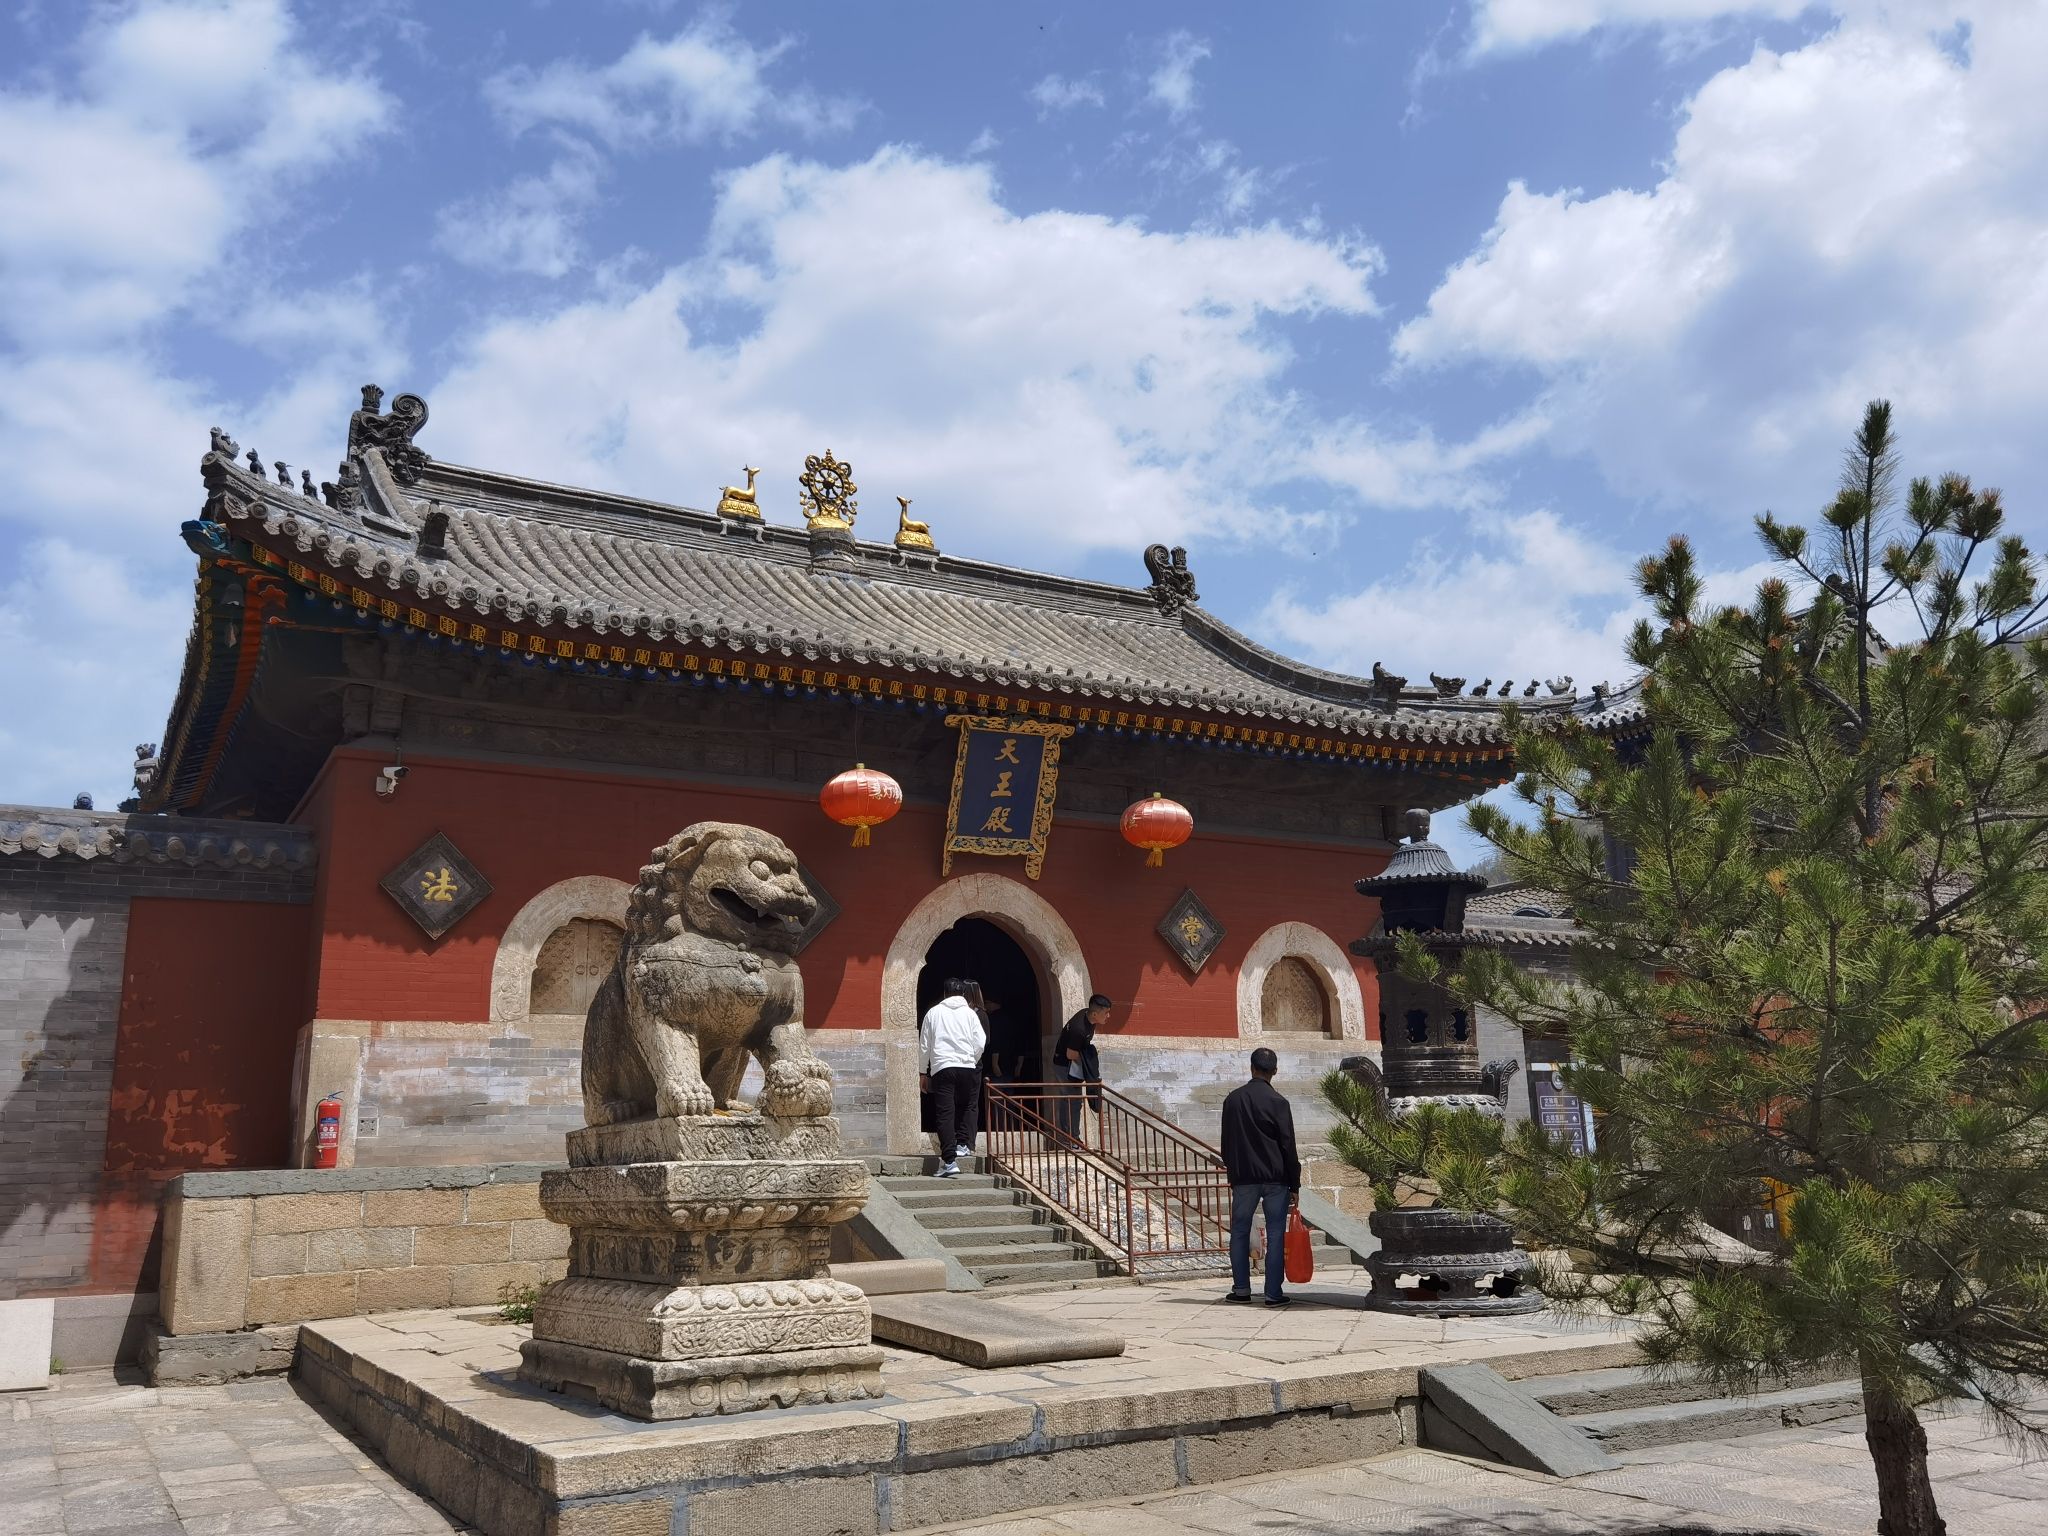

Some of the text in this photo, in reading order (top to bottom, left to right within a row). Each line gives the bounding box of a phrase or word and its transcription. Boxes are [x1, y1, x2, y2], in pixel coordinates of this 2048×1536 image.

[980, 738, 1020, 833] 天王殿
[420, 867, 458, 902] 法
[1178, 915, 1204, 946] 常
